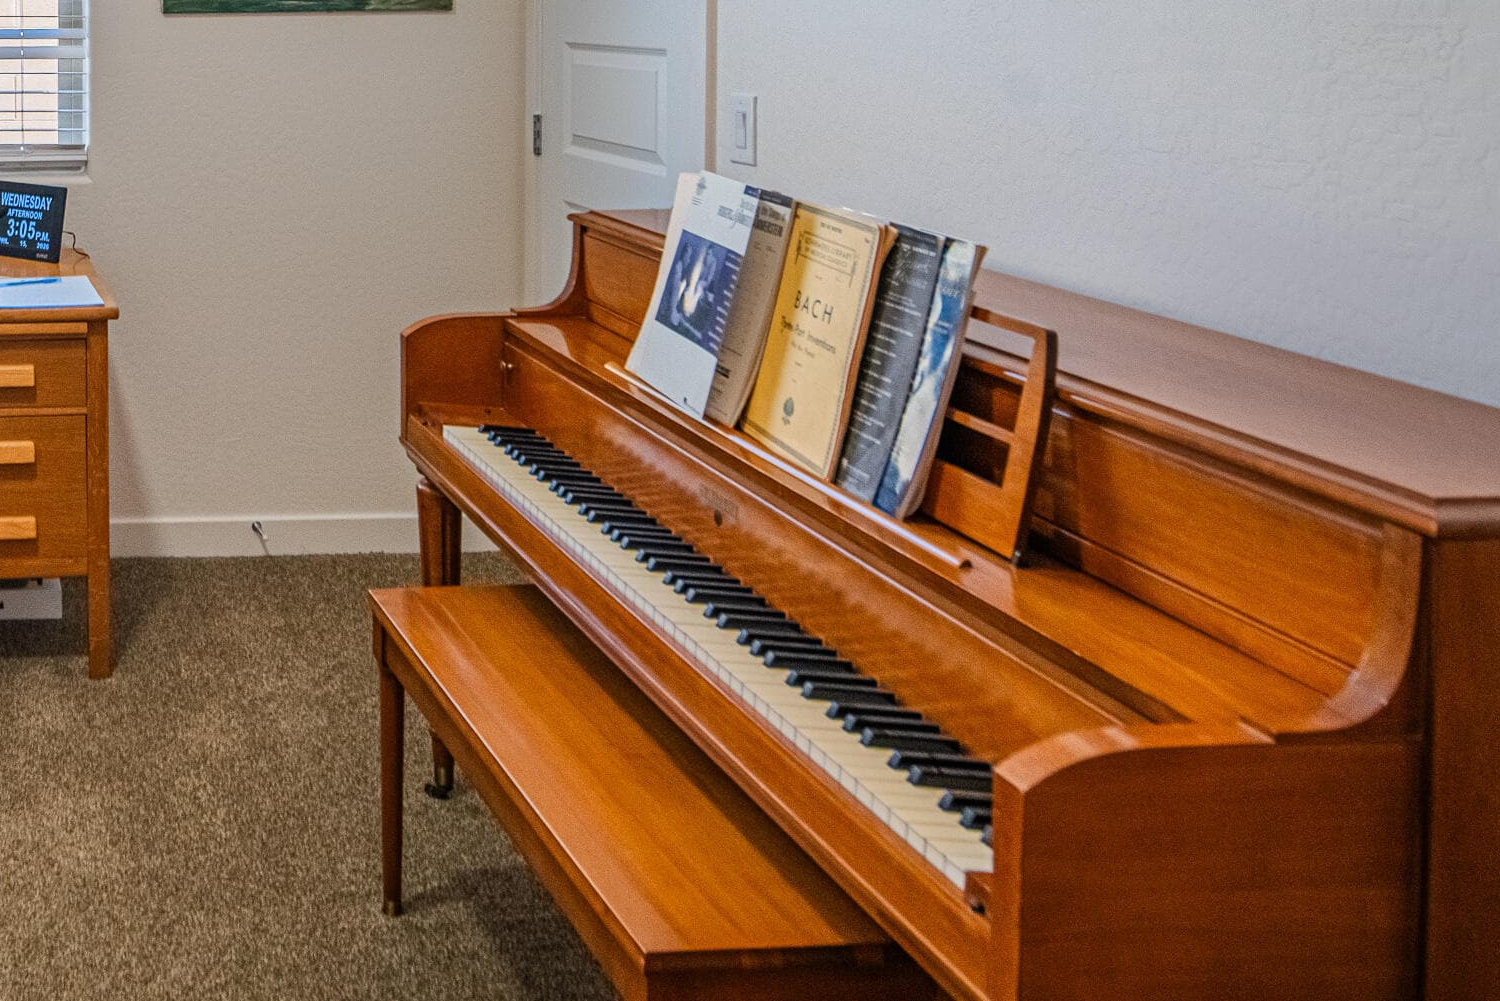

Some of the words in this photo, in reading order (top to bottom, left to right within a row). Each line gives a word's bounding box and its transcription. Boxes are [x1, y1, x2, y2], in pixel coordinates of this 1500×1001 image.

[1, 192, 53, 211] WEDNESDAY
[7, 208, 43, 220] AFTERNOON
[7, 218, 36, 240] 3:05
[35, 231, 50, 242] P.M.
[794, 290, 834, 324] BACH
